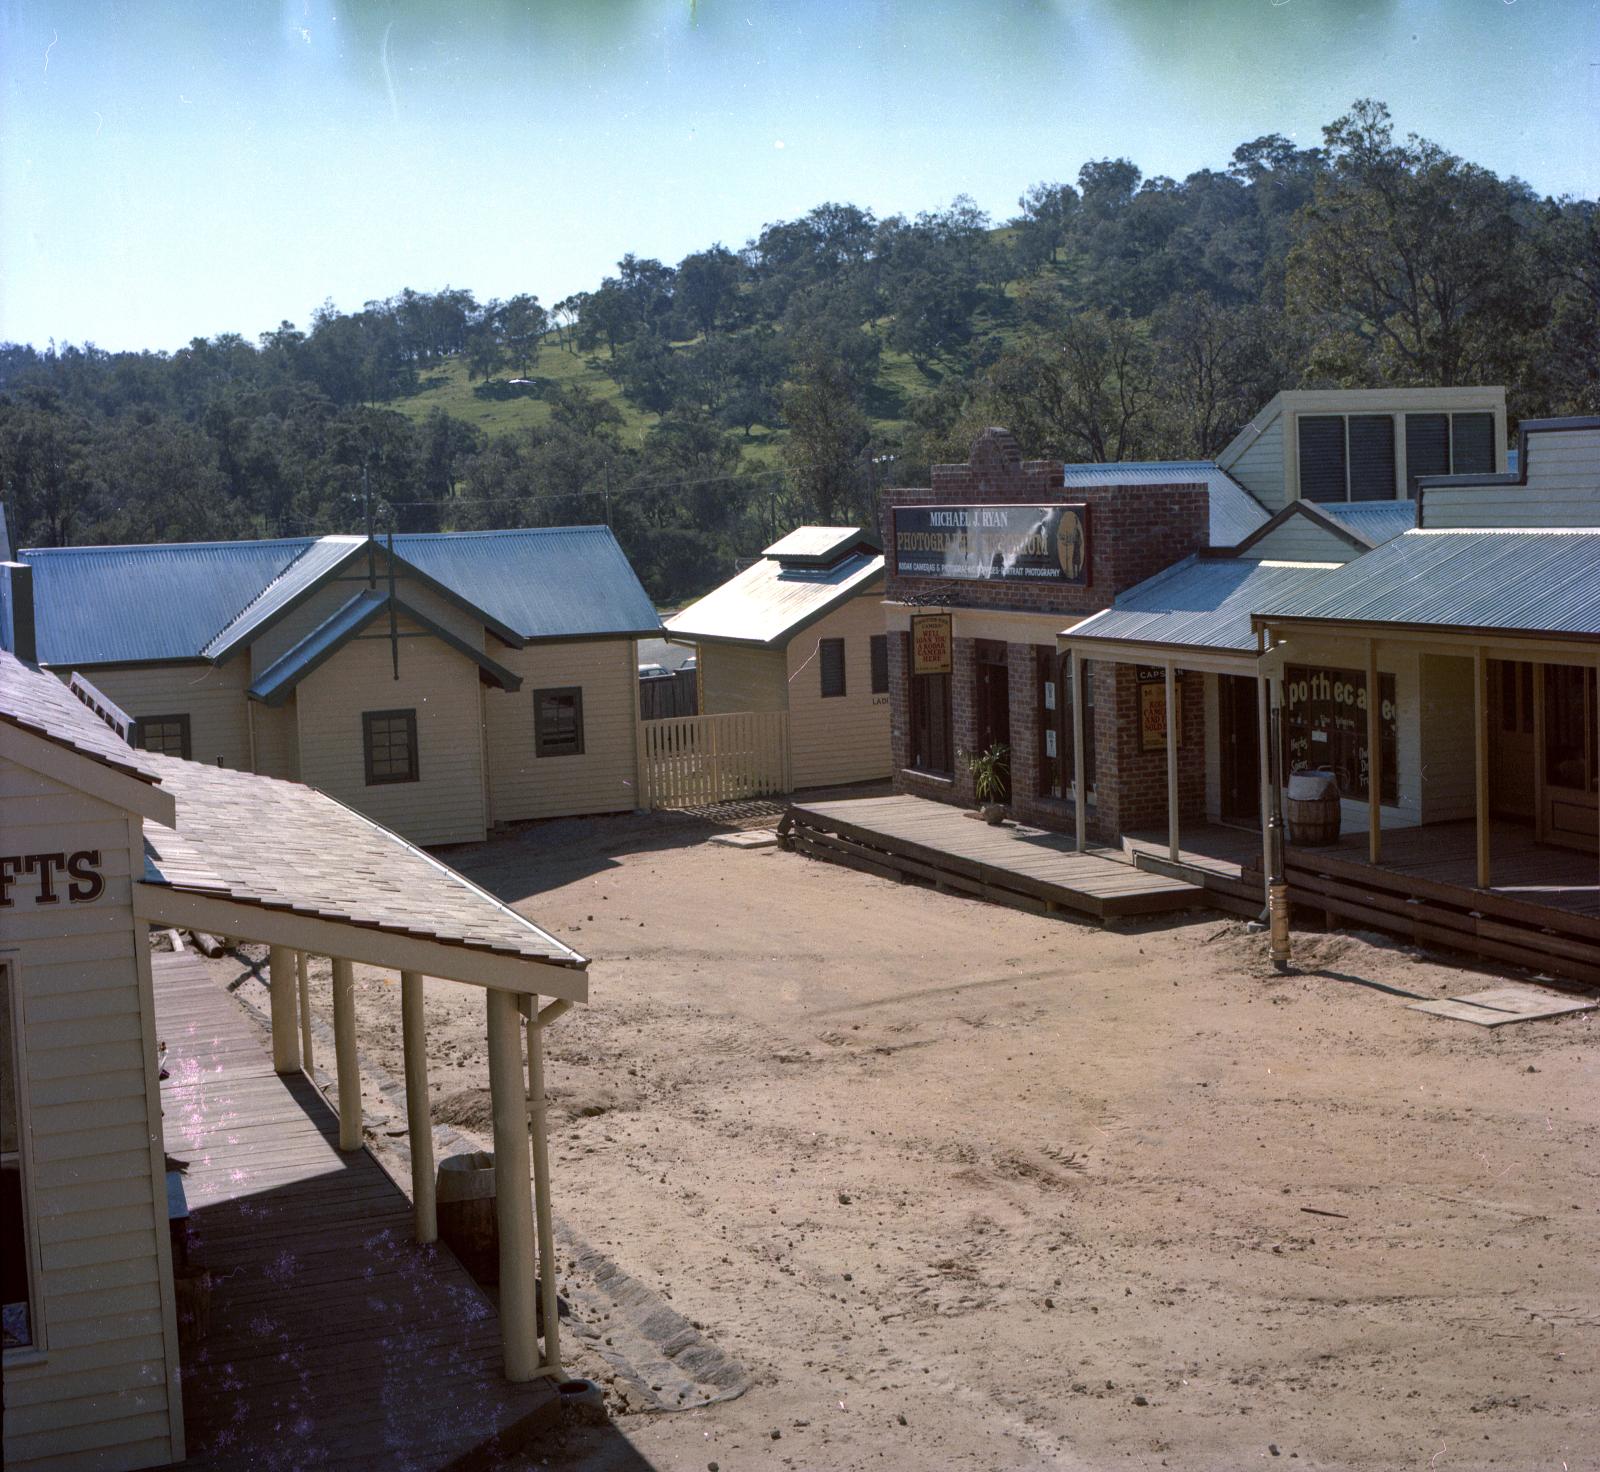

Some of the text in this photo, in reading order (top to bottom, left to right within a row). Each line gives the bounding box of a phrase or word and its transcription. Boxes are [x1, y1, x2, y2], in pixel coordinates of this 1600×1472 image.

[930, 511, 1008, 528] MICHAEL J. RYAN
[1025, 567, 1060, 577] PHOTOGRAPHY
[0, 850, 105, 908] FTS
